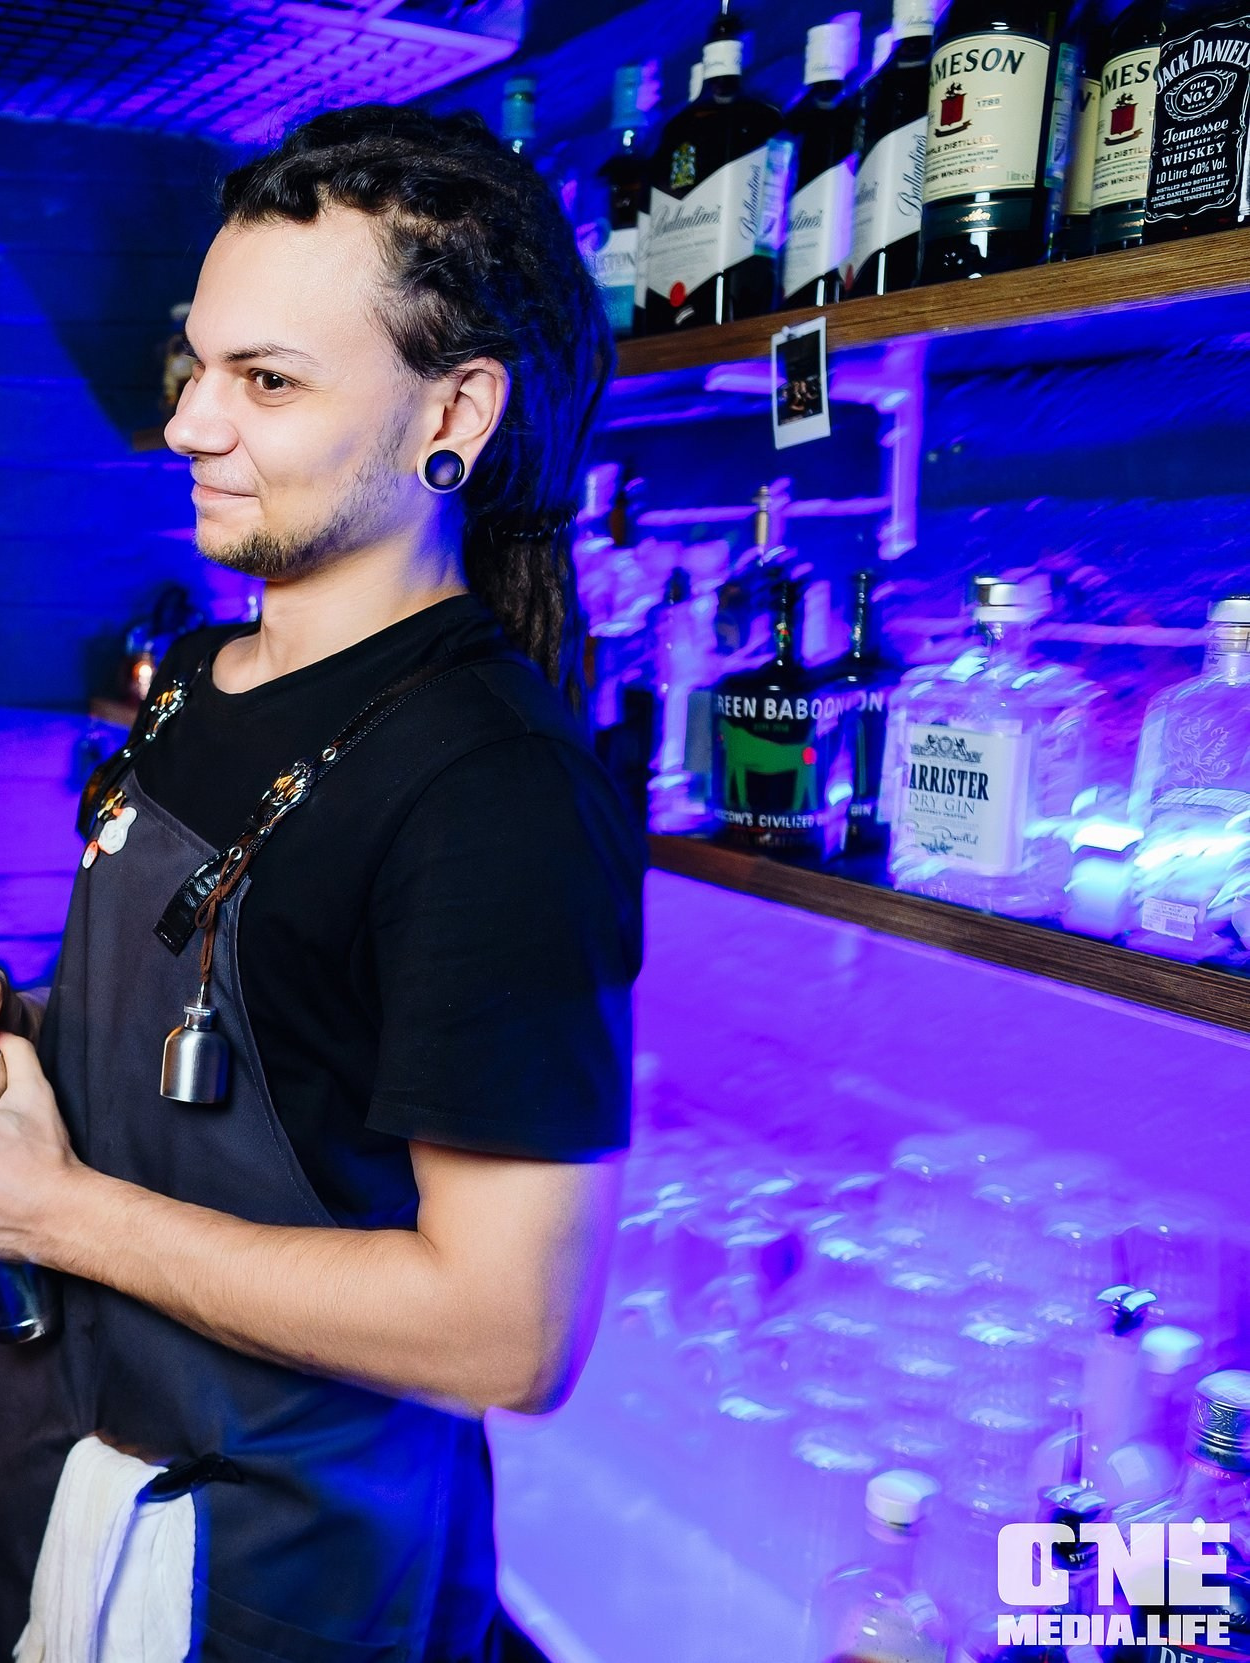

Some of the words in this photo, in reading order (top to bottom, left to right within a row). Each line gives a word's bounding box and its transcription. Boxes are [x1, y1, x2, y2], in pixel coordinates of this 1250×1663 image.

[1101, 60, 1159, 98] MES
[1156, 50, 1190, 94] JACK
[1190, 80, 1207, 91] Old
[1162, 119, 1229, 146] Tennessee
[1176, 141, 1191, 150] SOUR
[1193, 137, 1211, 146] MASH
[1161, 141, 1226, 167] WHISKEY
[1168, 169, 1188, 181] Litre
[1190, 161, 1210, 176] 40%
[1212, 157, 1228, 171] Vol.
[1181, 180, 1192, 188] AND
[763, 697, 847, 721] BABOON
[910, 791, 938, 809] DRY
[945, 798, 975, 816] GIN
